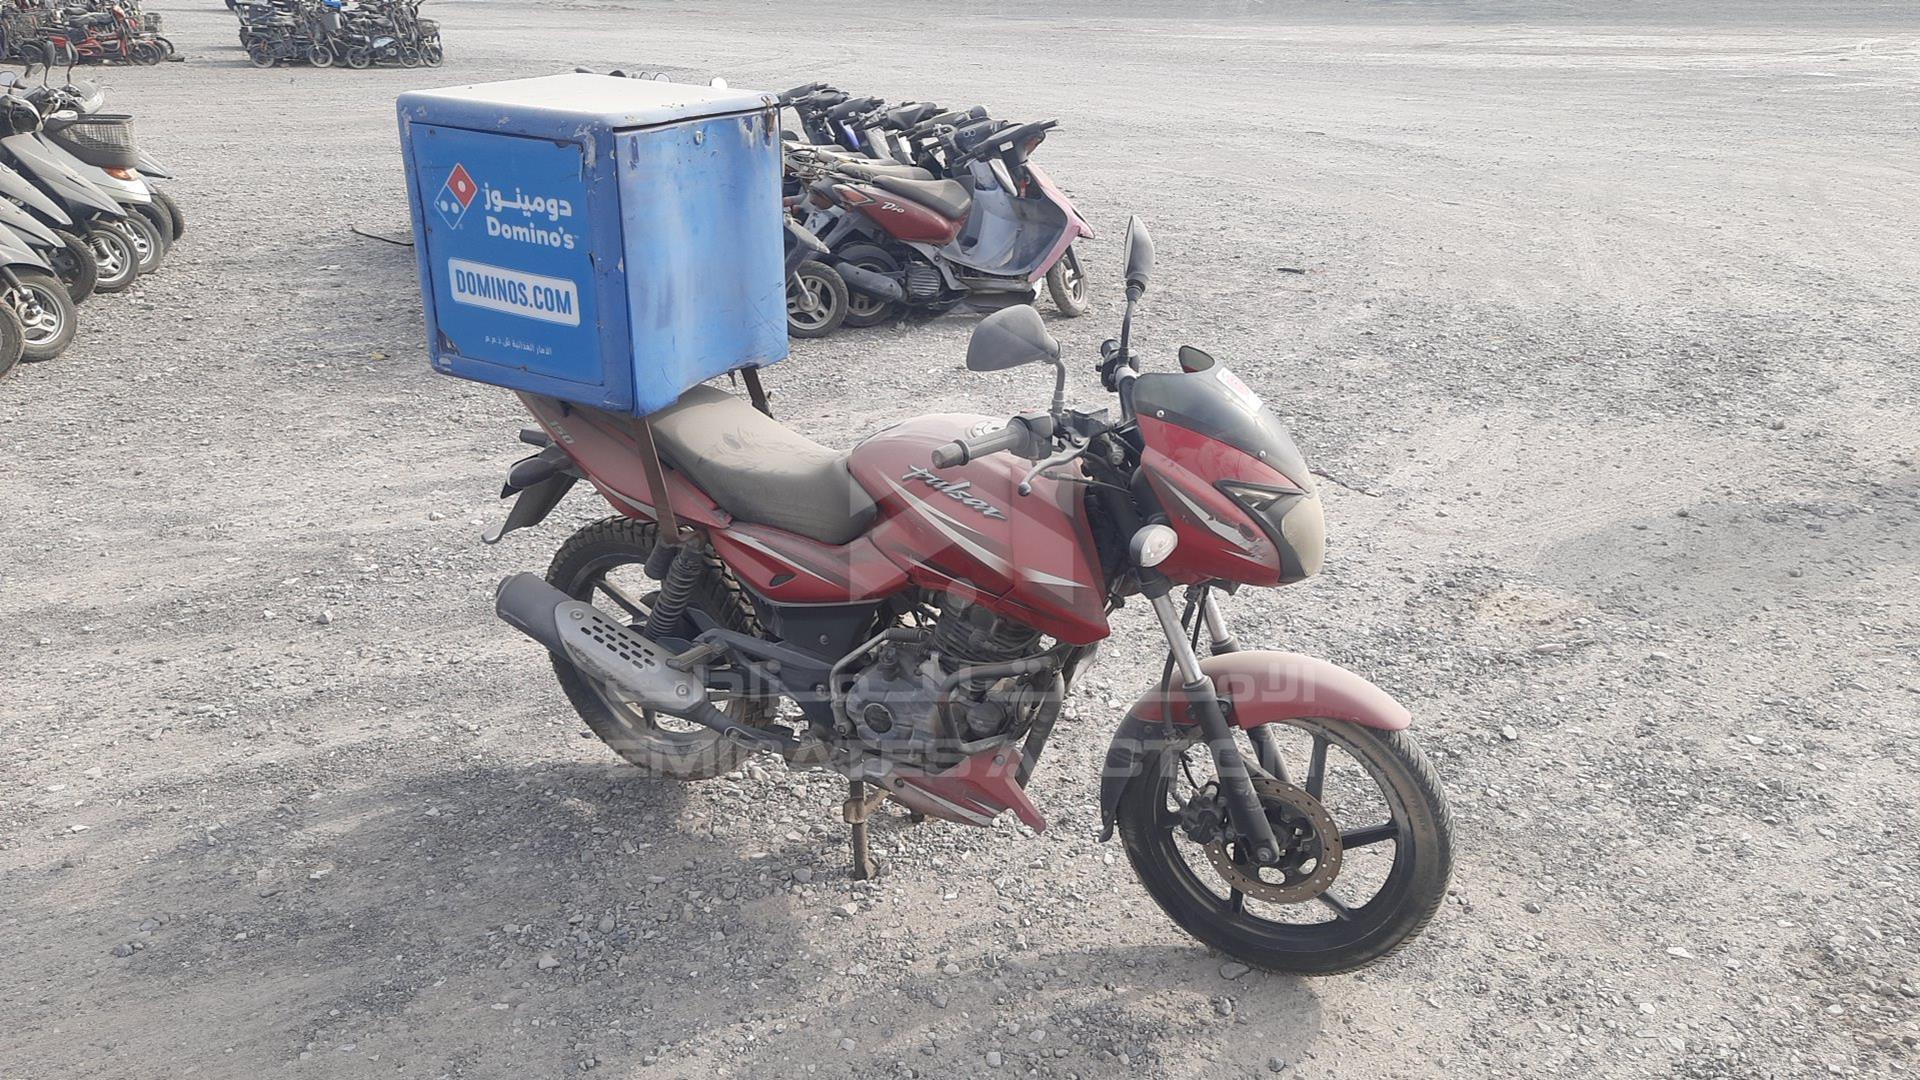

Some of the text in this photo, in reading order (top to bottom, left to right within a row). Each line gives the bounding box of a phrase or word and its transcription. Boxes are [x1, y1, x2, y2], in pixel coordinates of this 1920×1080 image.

[484, 182, 573, 221] دومينوز
[486, 215, 575, 250] Domino's
[455, 268, 573, 315] DOMINOS.COM
